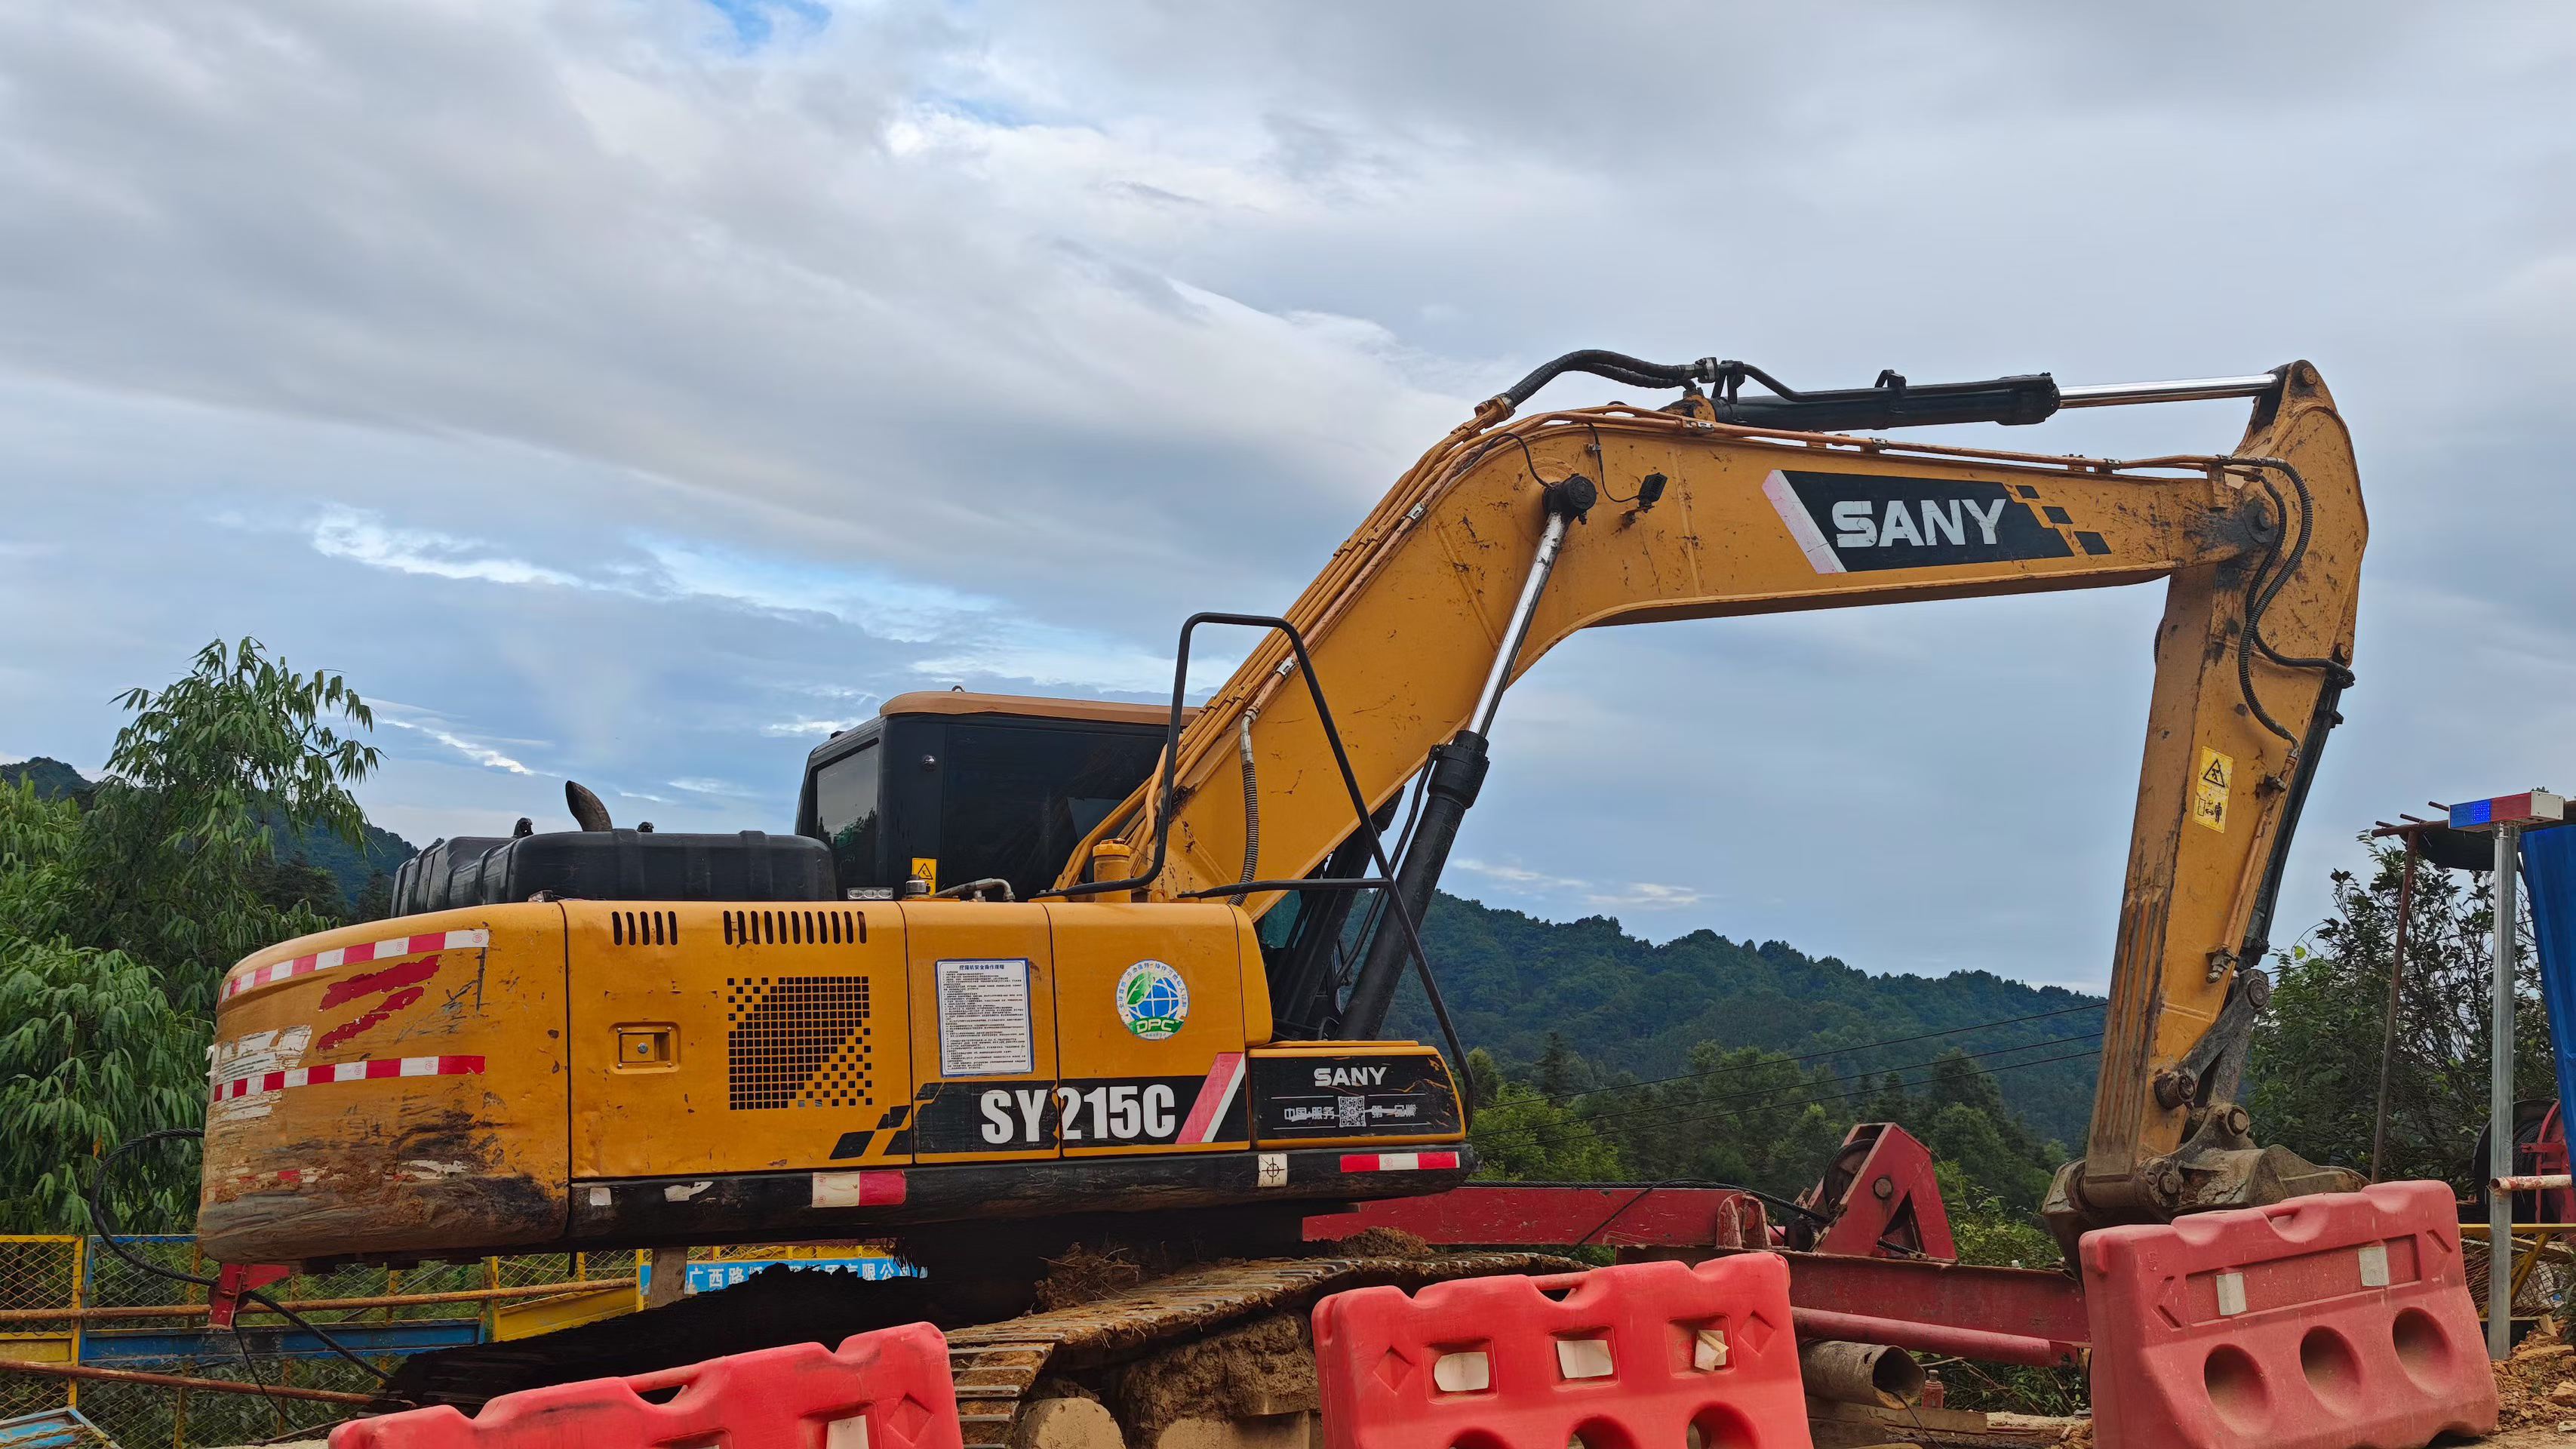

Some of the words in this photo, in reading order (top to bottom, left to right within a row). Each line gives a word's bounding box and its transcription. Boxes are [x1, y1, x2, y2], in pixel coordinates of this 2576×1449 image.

[1831, 498, 2006, 548] SANY
[1136, 1018, 1175, 1033] DPC
[1313, 1066, 1387, 1087] SANY
[980, 1084, 1176, 1144] SY215C
